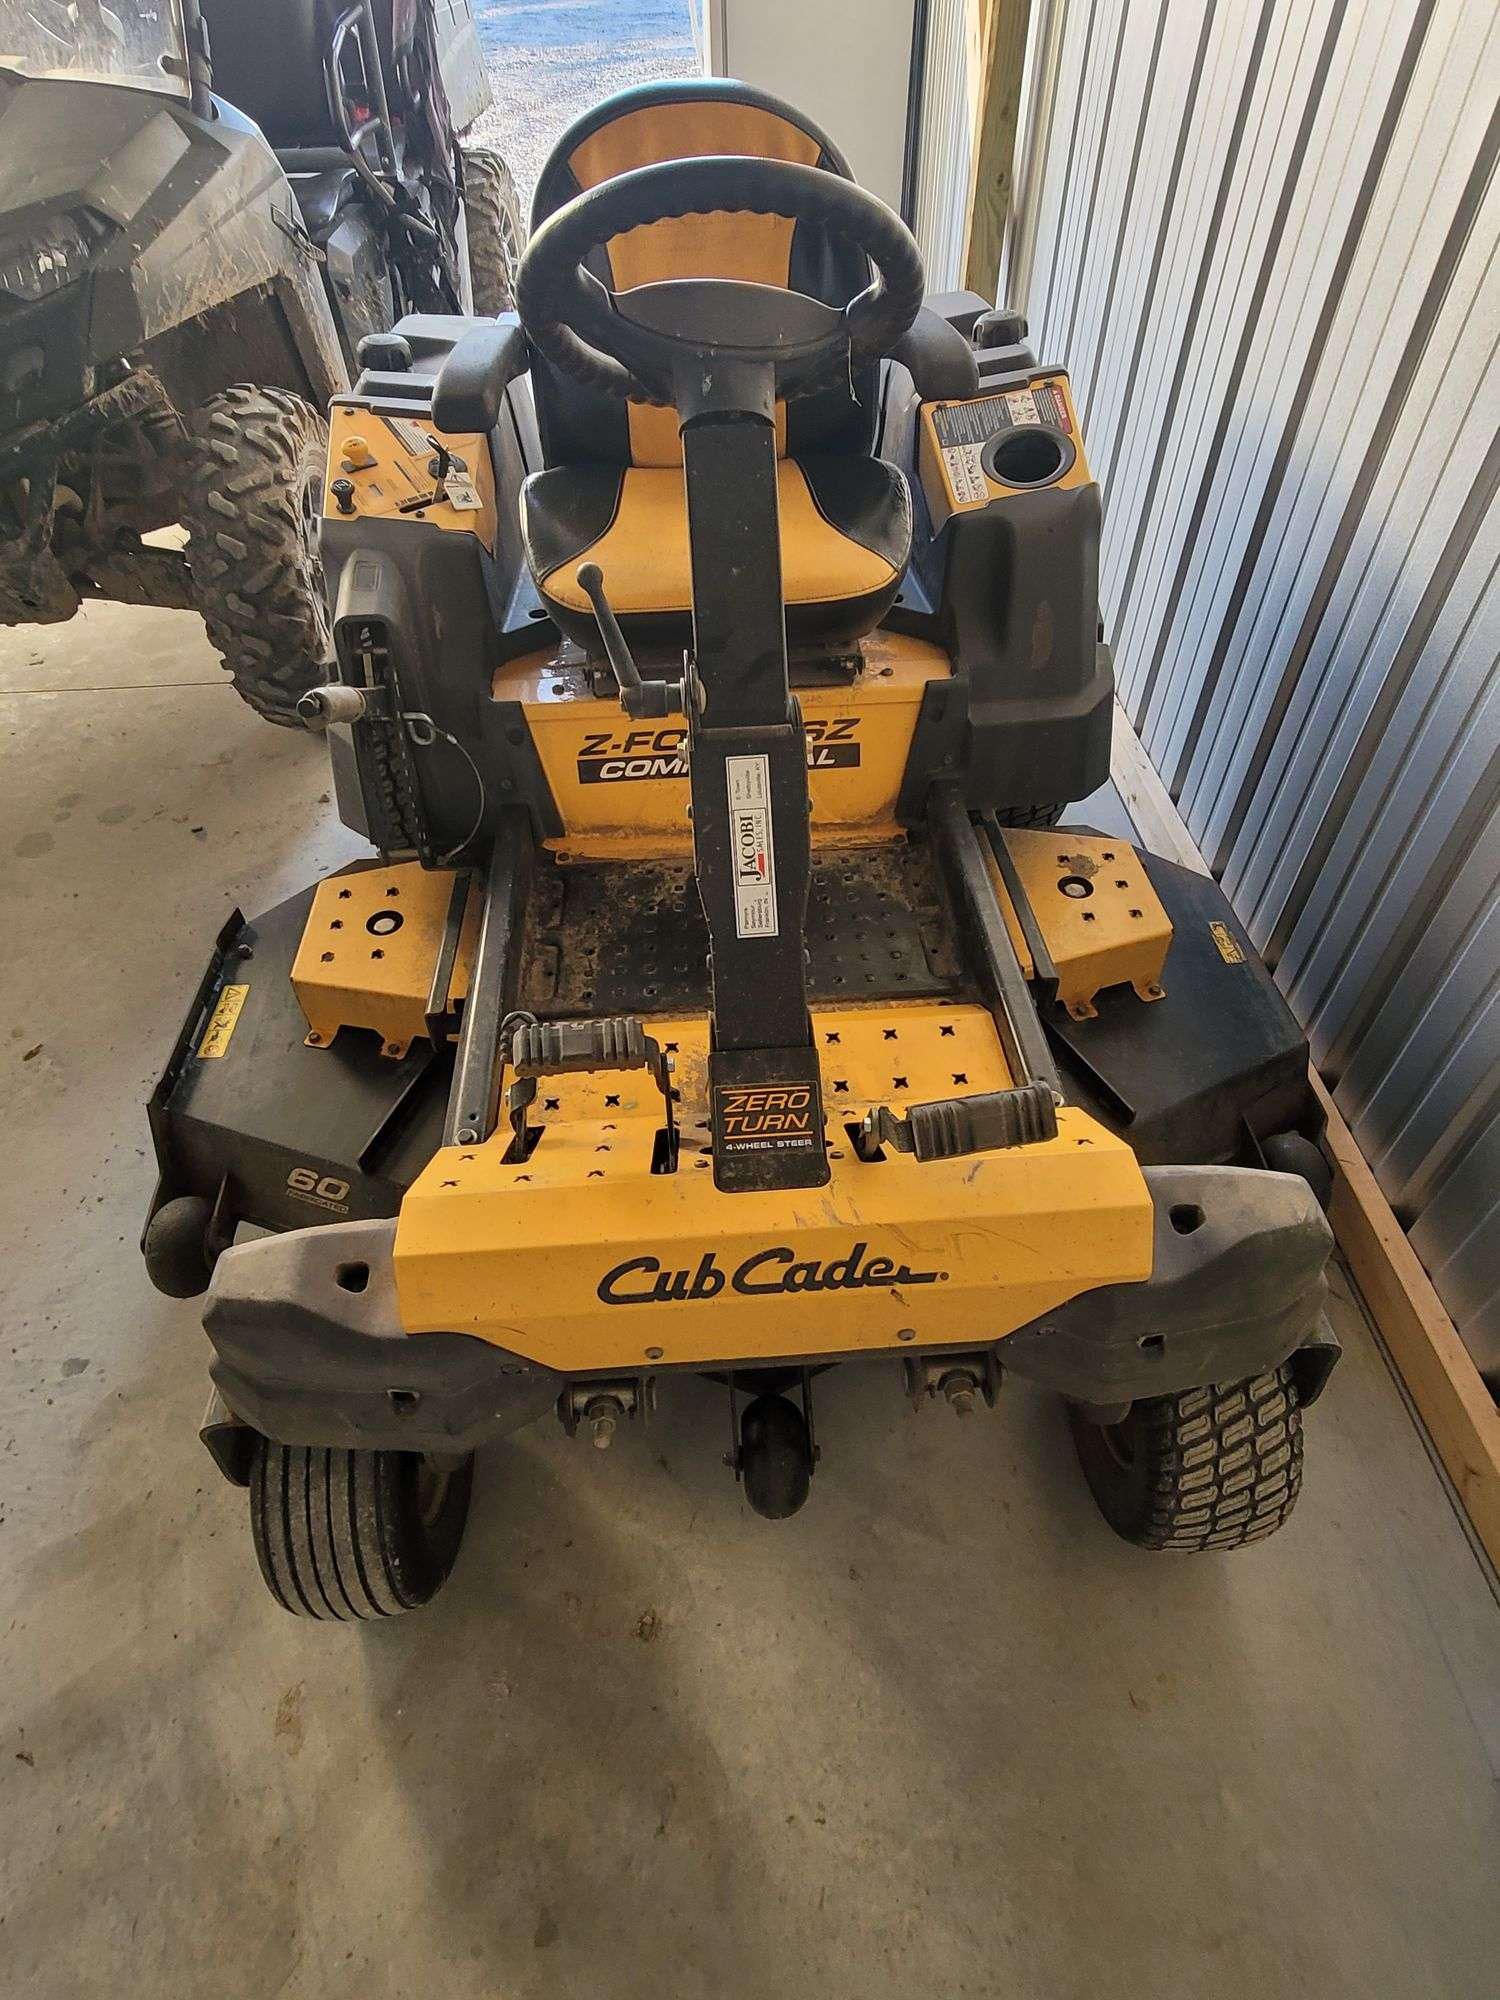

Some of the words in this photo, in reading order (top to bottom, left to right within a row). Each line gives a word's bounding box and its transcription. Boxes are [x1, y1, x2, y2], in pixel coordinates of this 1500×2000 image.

[740, 815, 761, 881] JACOBI
[723, 1092, 810, 1113] ZERO
[724, 1112, 809, 1133] TURN
[725, 1141, 773, 1151] 4-WHEEL
[776, 1139, 813, 1148] STEER
[287, 1168, 350, 1200] 60
[597, 1252, 726, 1305] Cub
